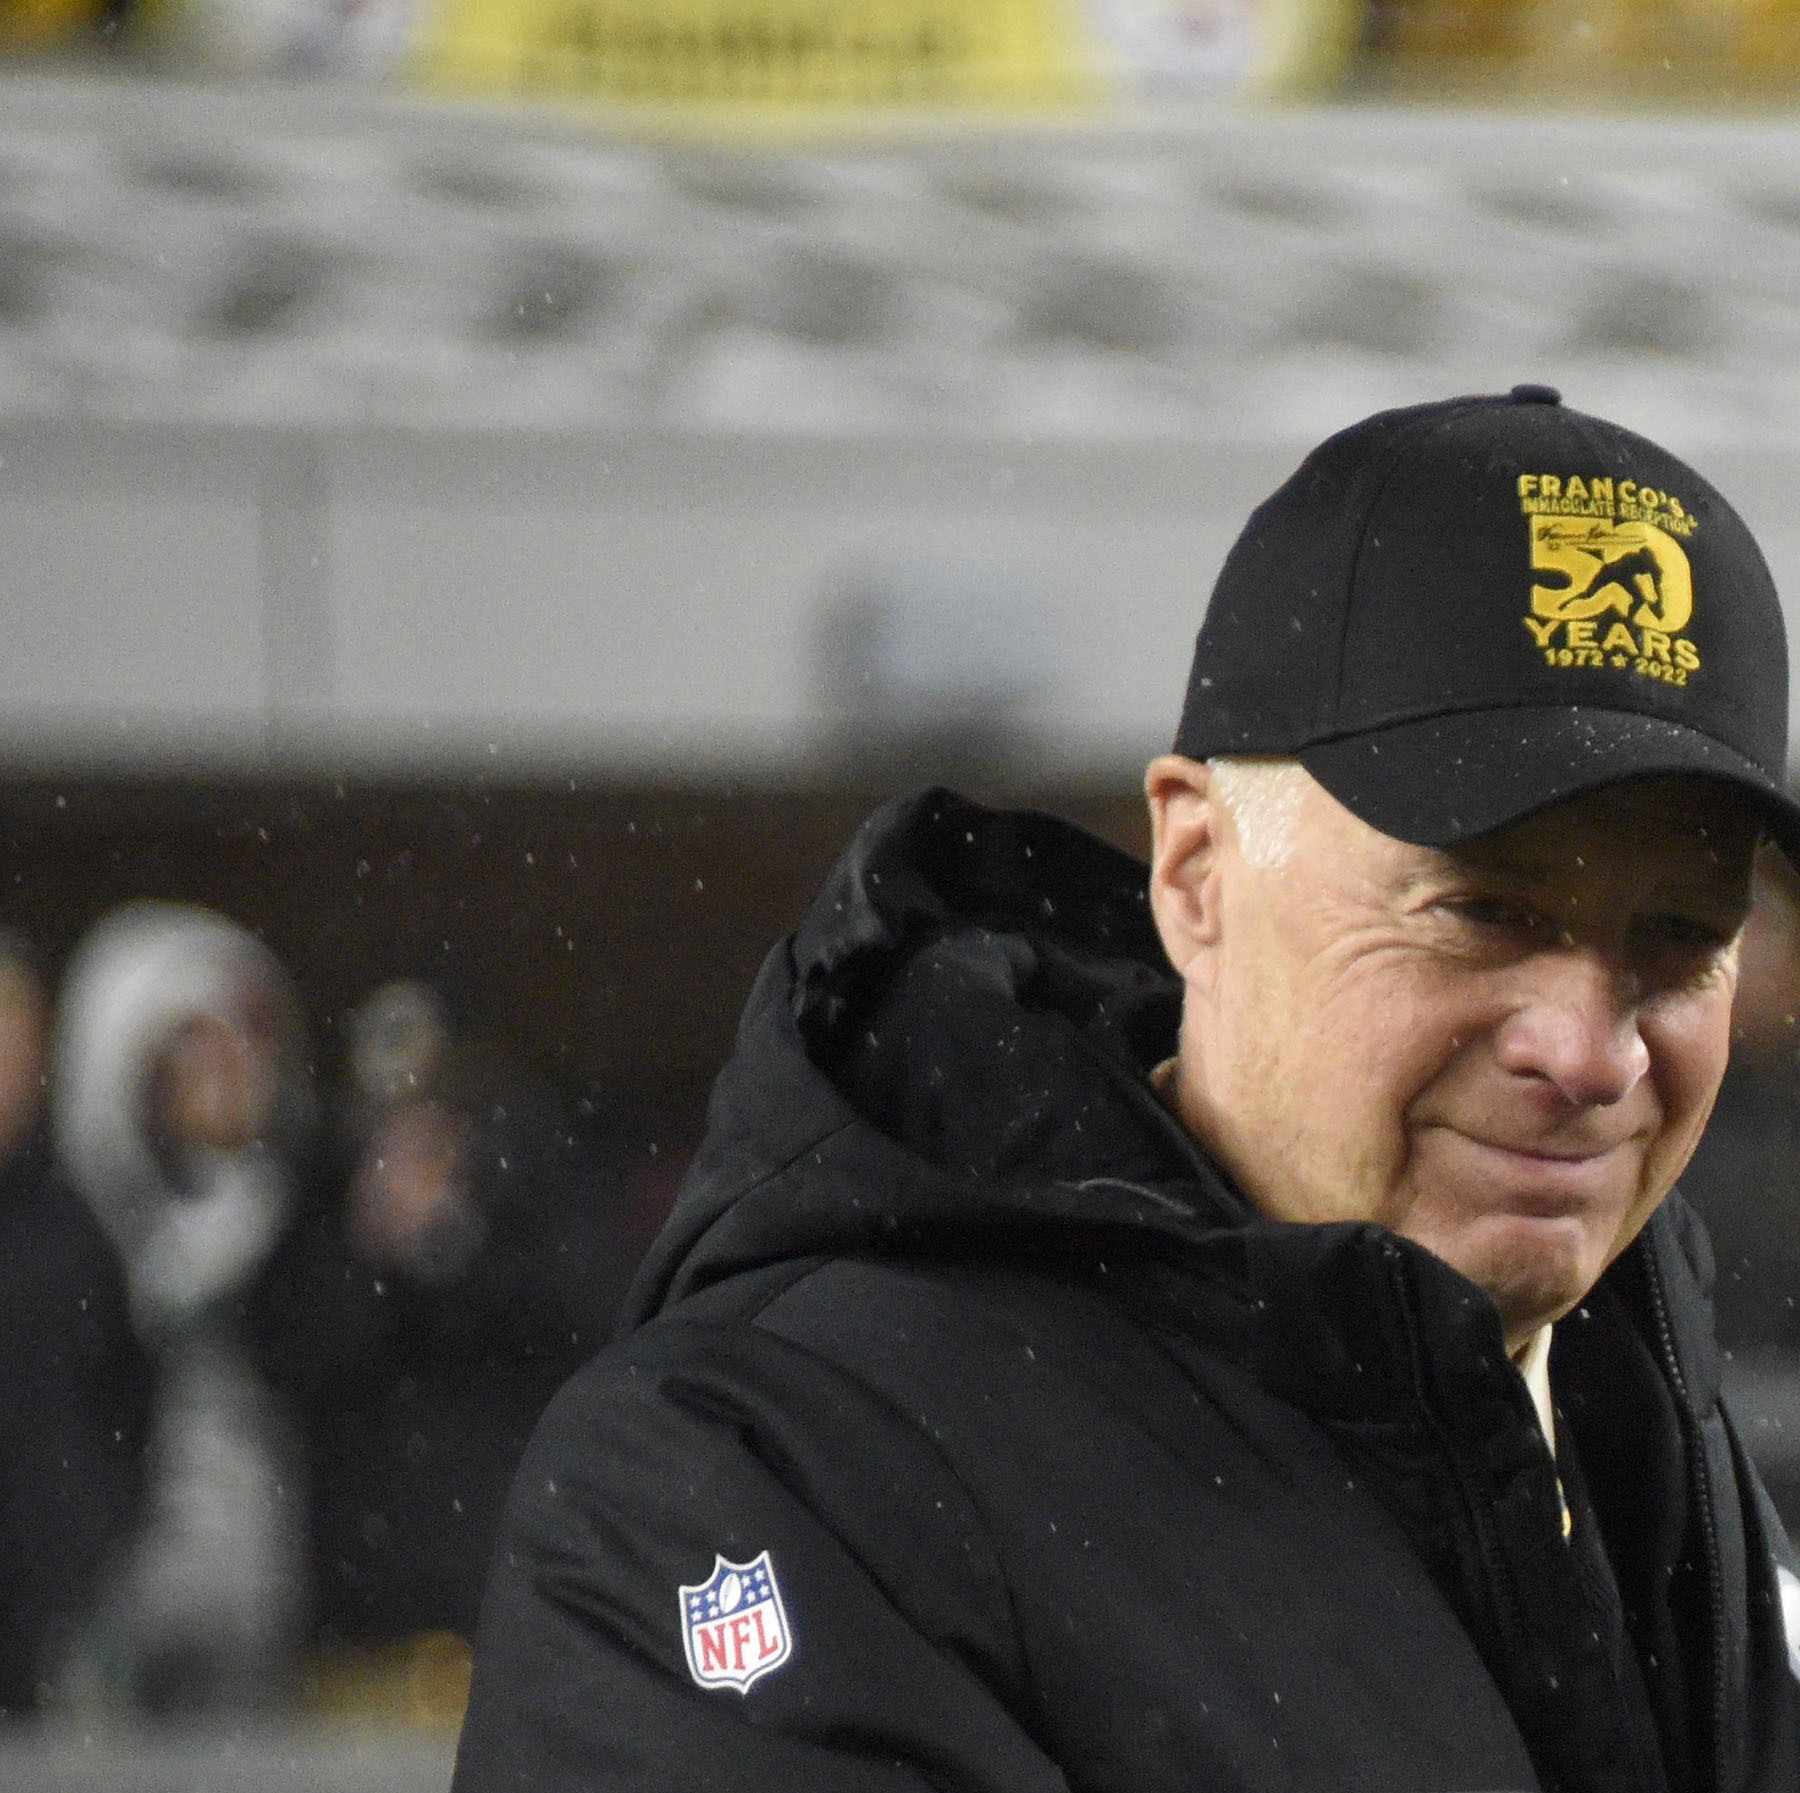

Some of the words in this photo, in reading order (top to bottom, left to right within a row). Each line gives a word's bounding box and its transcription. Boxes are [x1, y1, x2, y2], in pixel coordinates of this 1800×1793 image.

[1518, 474, 1685, 518] FRANCO'S
[1522, 617, 1700, 671] YEARS
[1546, 649, 1604, 668] 1972
[1636, 657, 1687, 687] 2022
[697, 1609, 779, 1671] NFL
